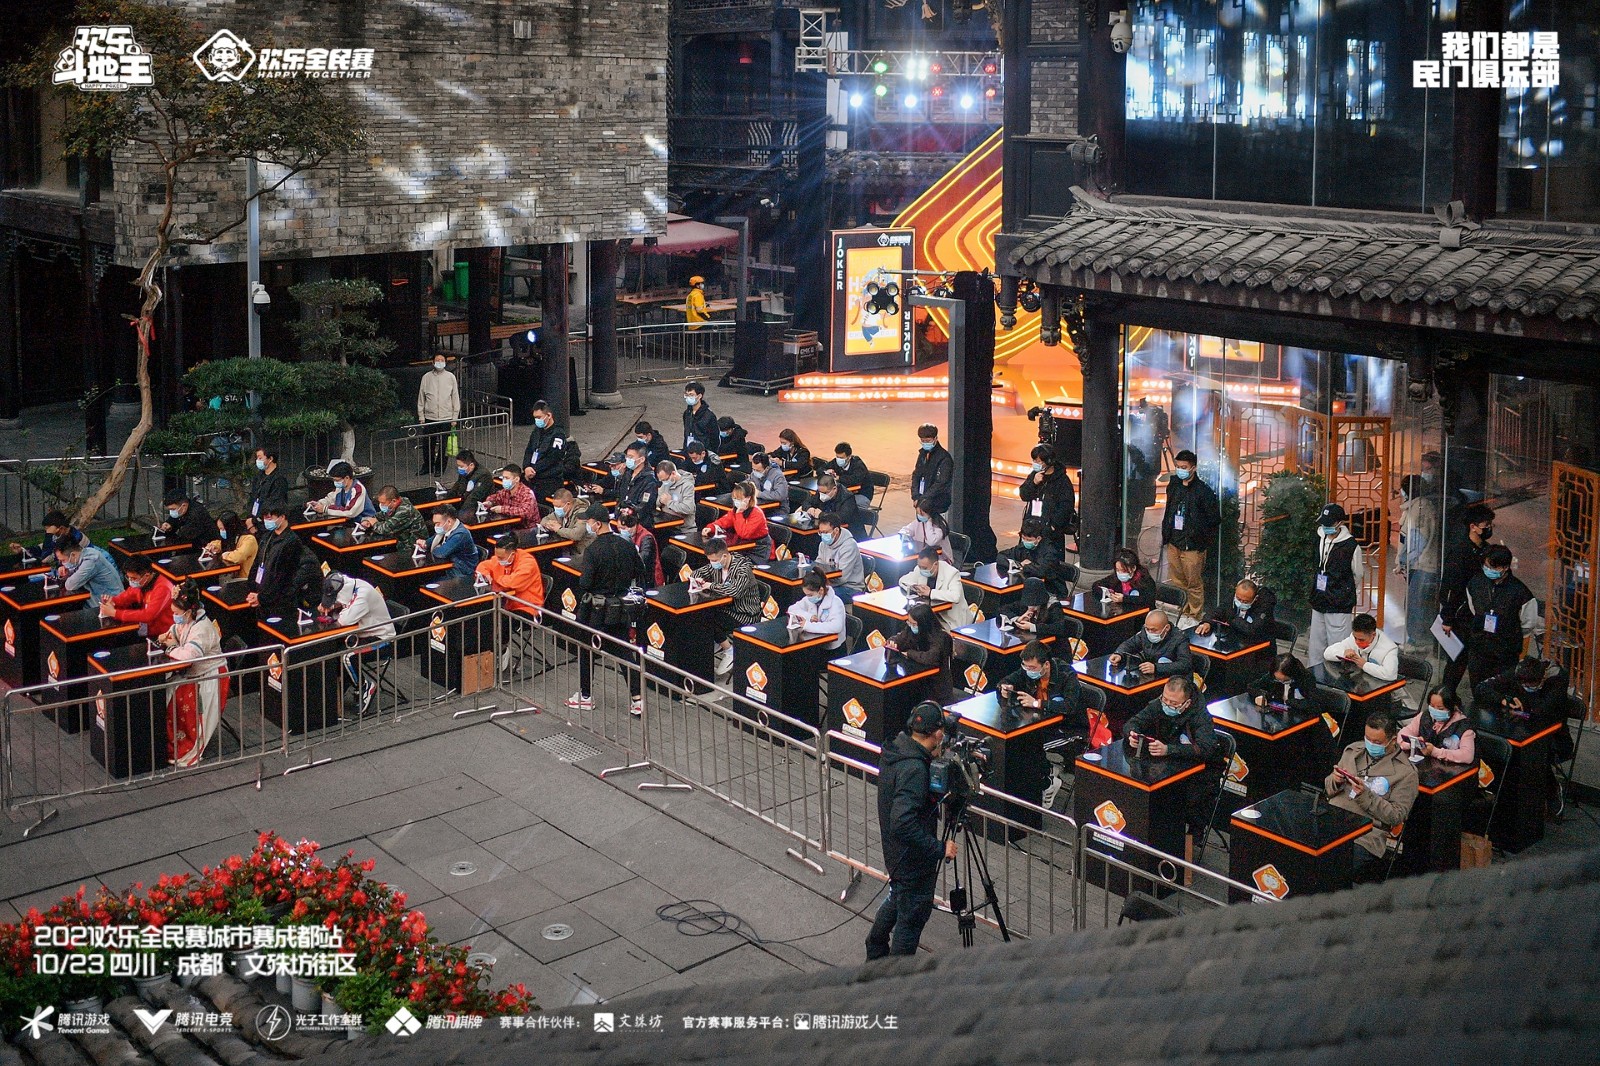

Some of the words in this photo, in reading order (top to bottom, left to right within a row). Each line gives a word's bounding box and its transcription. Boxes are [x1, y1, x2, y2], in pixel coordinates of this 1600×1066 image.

[836, 238, 844, 290] JOKER
[903, 310, 911, 362] JOKER
[552, 438, 563, 450] R
